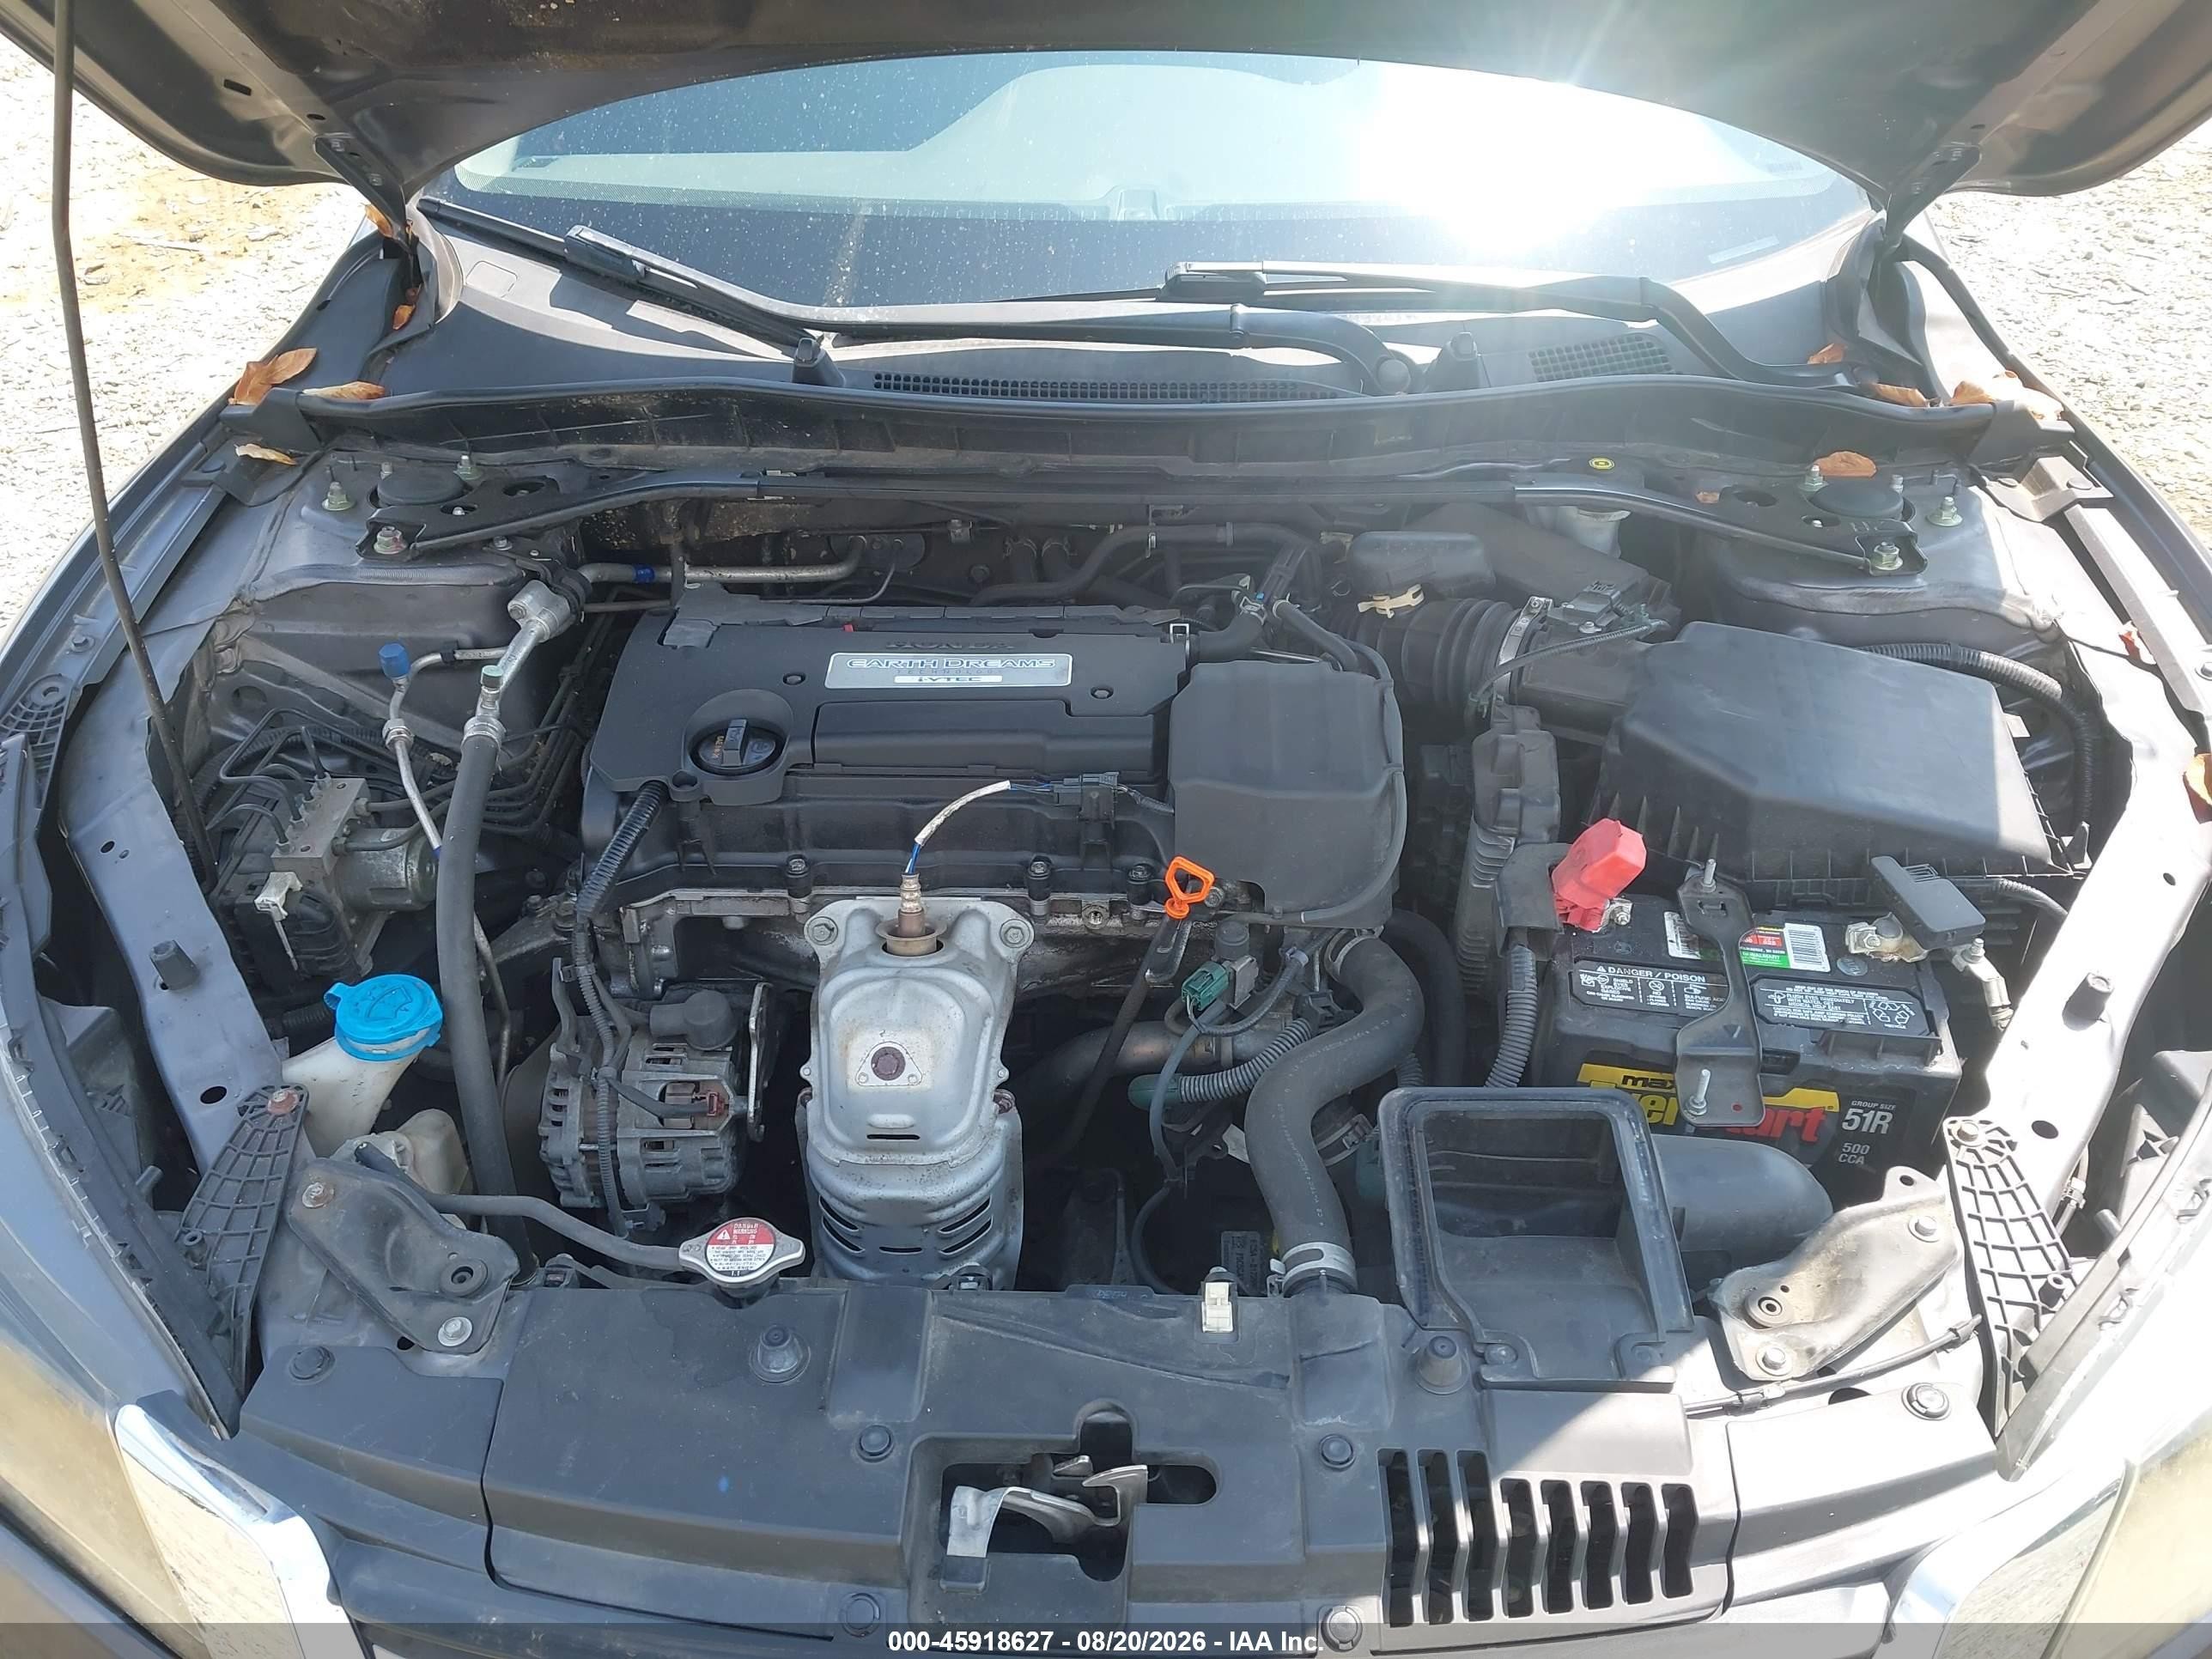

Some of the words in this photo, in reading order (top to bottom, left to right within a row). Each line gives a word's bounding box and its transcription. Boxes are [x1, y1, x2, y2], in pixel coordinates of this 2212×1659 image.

[886, 641, 1014, 650] HONDA
[847, 659, 938, 669] EARTH
[943, 659, 1055, 669] DREAMS
[1607, 966, 1653, 978] DANGER
[1664, 972, 1706, 983] POISON
[1851, 1100, 1879, 1109] GROUP
[1842, 1108, 1893, 1134] 51R
[1842, 1142, 1870, 1155] 500
[1838, 1153, 1865, 1164] CCA
